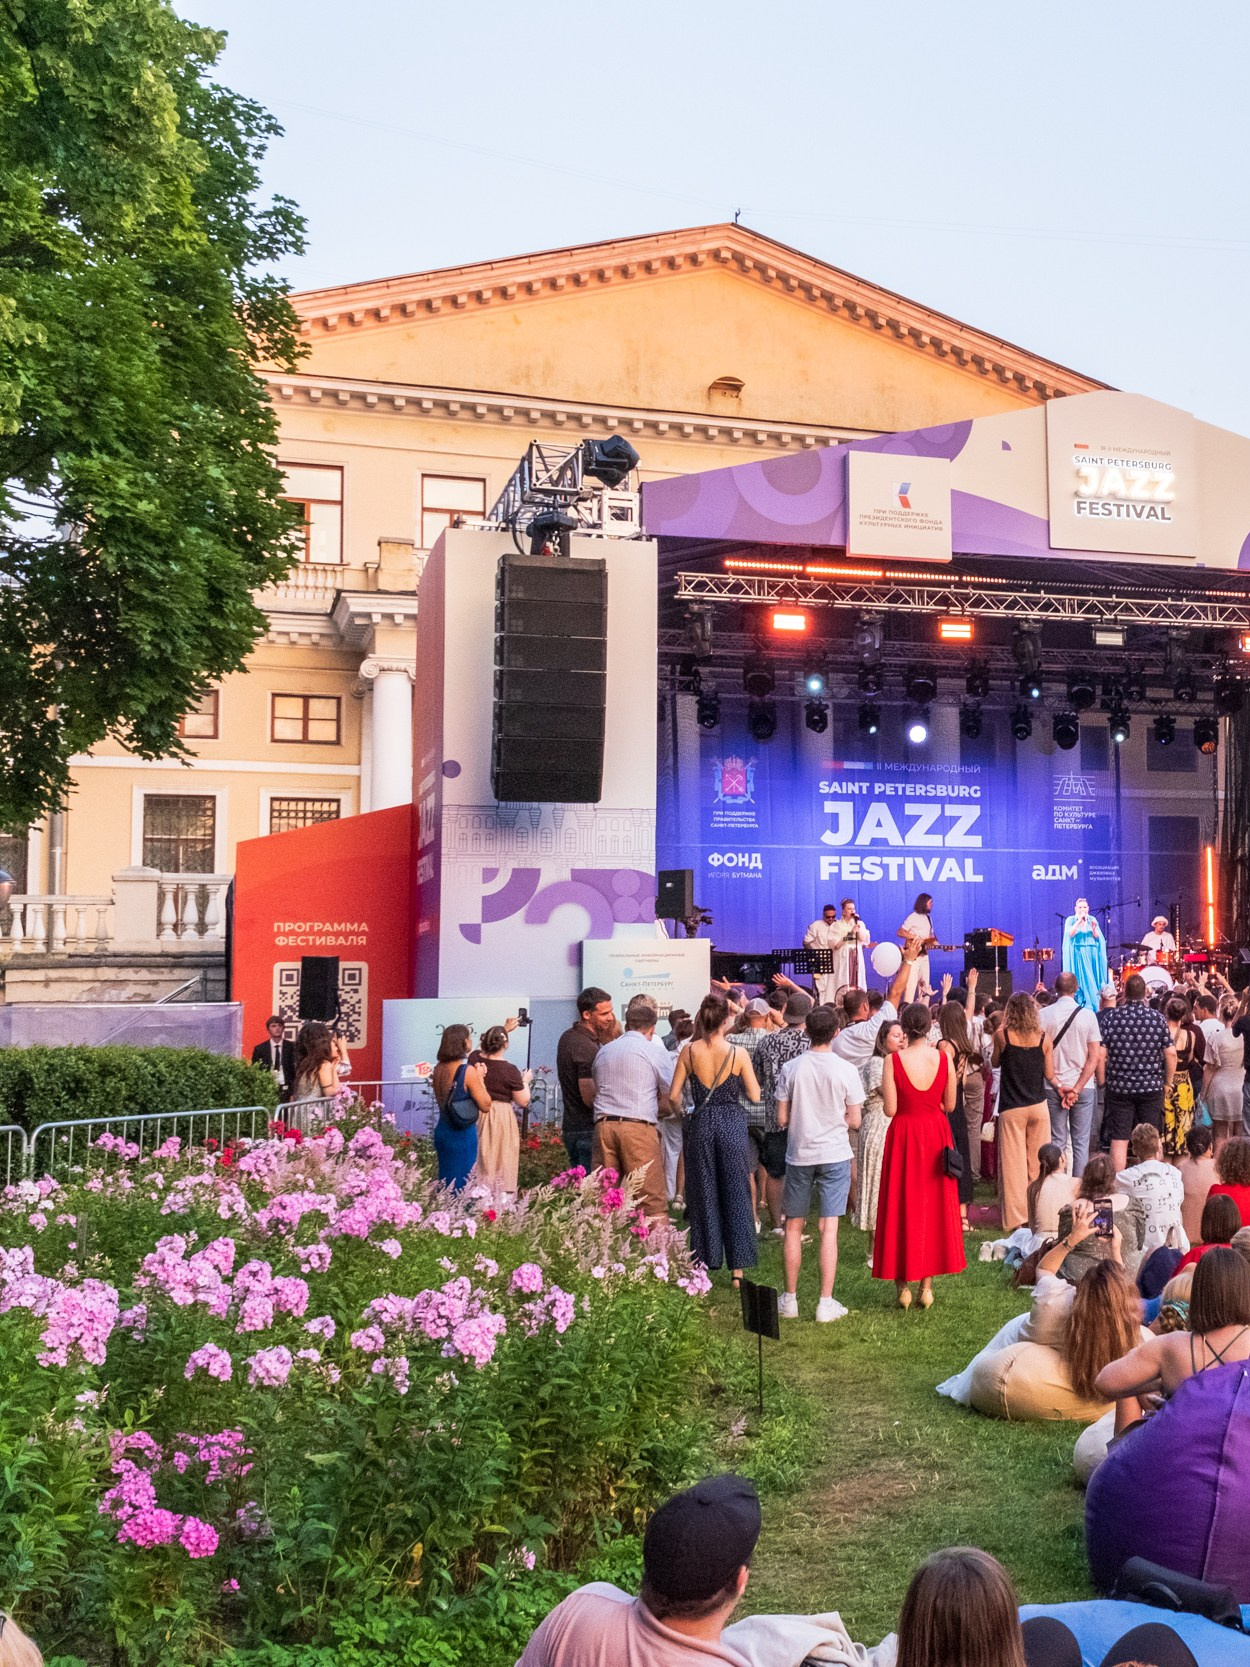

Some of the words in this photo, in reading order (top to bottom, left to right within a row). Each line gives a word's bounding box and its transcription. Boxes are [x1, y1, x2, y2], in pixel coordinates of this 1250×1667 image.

[1074, 455, 1105, 465] SAINT
[1107, 458, 1172, 471] PETERSBURG
[1074, 466, 1176, 503] JAZZ
[888, 509, 929, 518] ПОДДЕРЖКЕ
[1076, 500, 1172, 521] FESTIVAL
[859, 513, 918, 524] ПРЕЗИДЕНТСКОГО
[919, 518, 943, 526] ФОНДА
[859, 521, 902, 529] КУЛЬТУРНЫХ
[904, 524, 944, 532] ИНИЦИАТИВ
[884, 762, 981, 774] МЕЖДУНАРОДНЫЙ
[819, 781, 870, 795] SAINT
[874, 782, 981, 798] PETERSBURG
[1064, 811, 1096, 819] КУЛЬТУРЕ
[819, 801, 983, 848] JAZZ
[708, 852, 763, 870] ФОНД
[819, 855, 984, 883] FESTIVAL
[273, 922, 369, 932] ПРОГРАММА
[275, 935, 367, 946] ФЕСТИВАЛЯ
